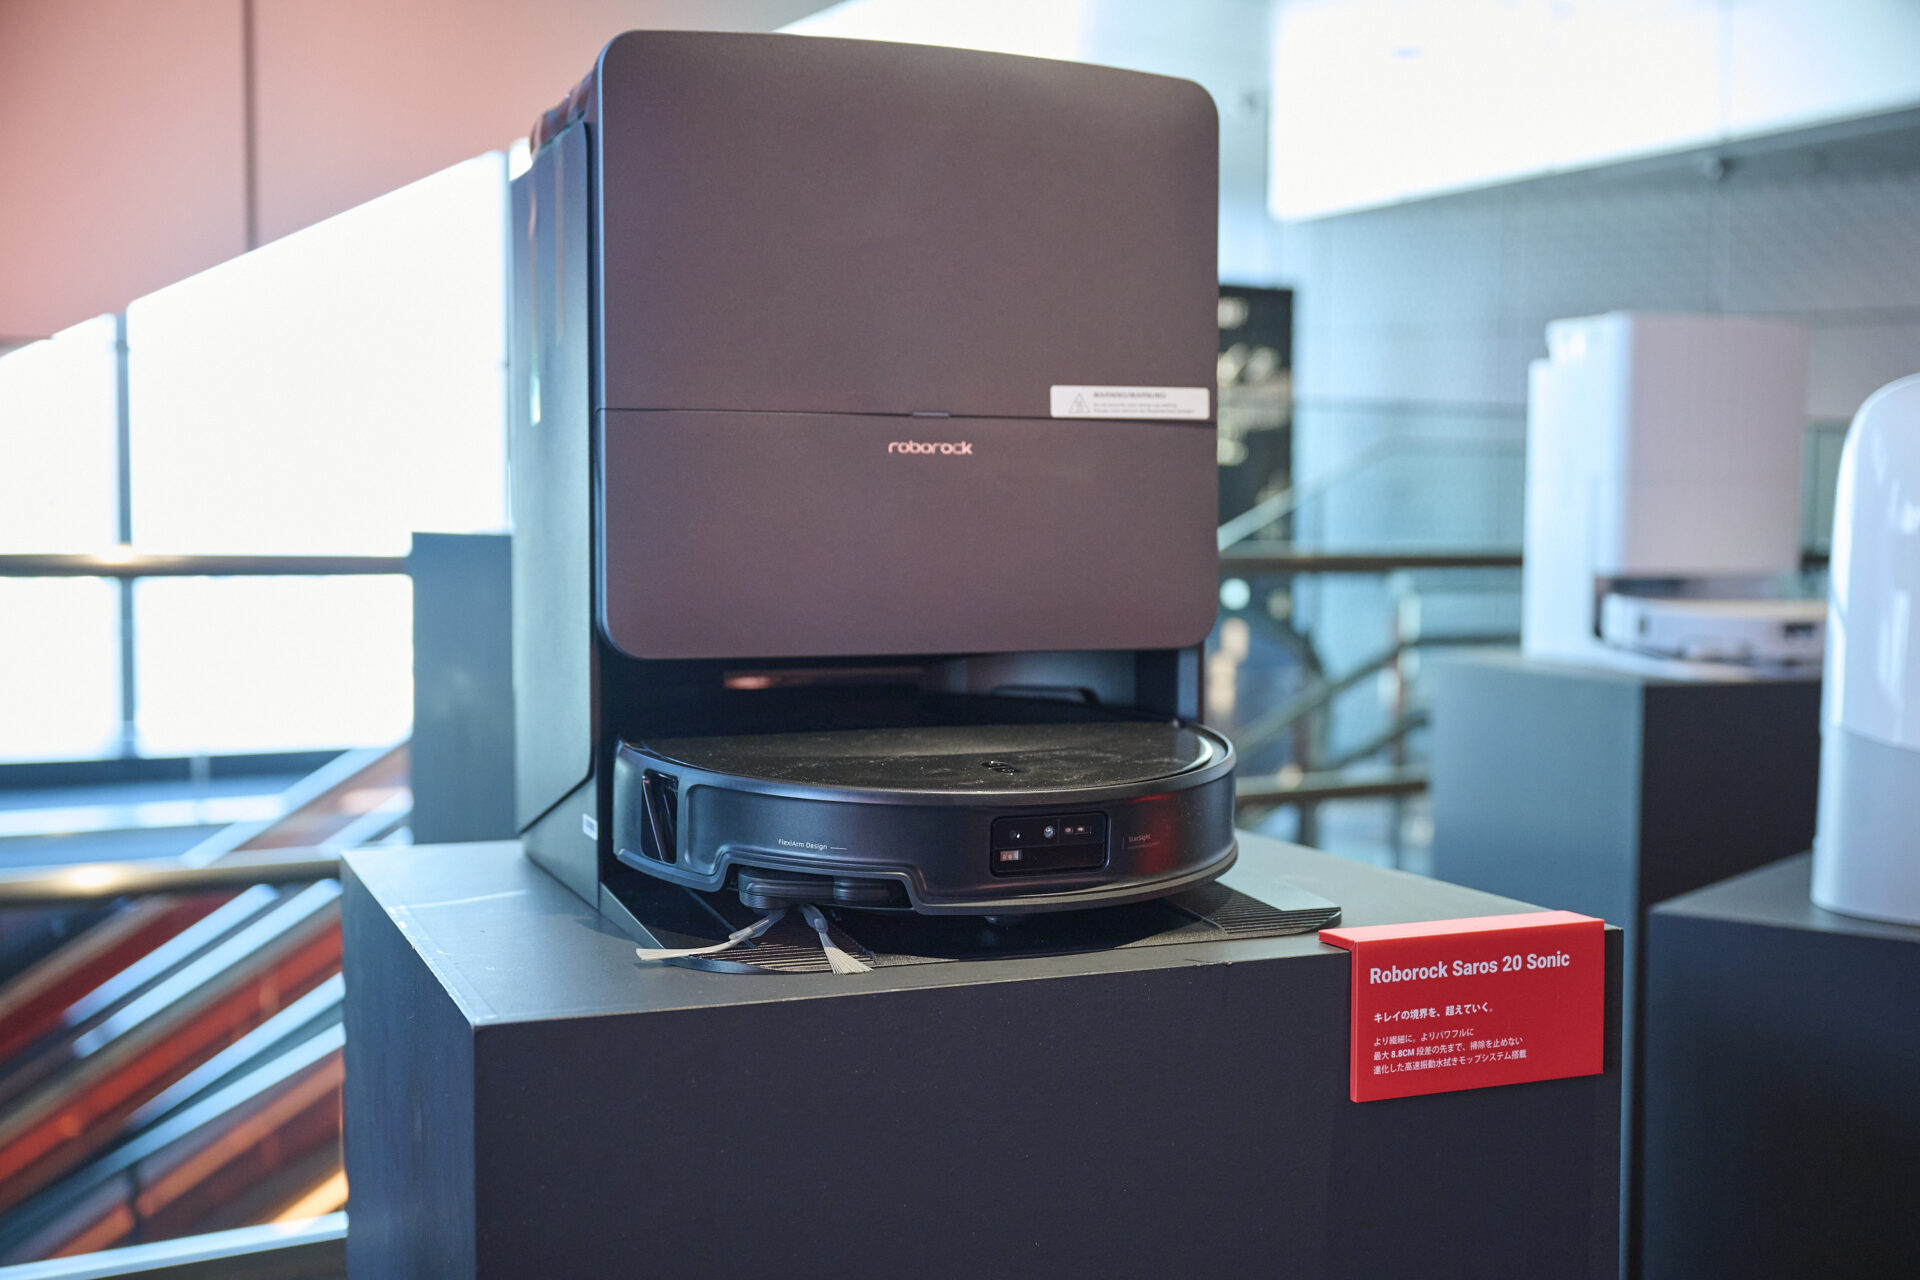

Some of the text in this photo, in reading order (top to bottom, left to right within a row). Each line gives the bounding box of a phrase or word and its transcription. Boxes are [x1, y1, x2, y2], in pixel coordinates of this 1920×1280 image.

[888, 440, 973, 455] roborock
[778, 838, 828, 851] FlexiArm Design
[1370, 950, 1570, 984] Roborock Saros 20 Sonic
[1374, 1002, 1493, 1023] キレイの境界を、超えていく。
[1373, 1051, 1390, 1061] 最大
[1391, 1048, 1415, 1058] 8.8CM
